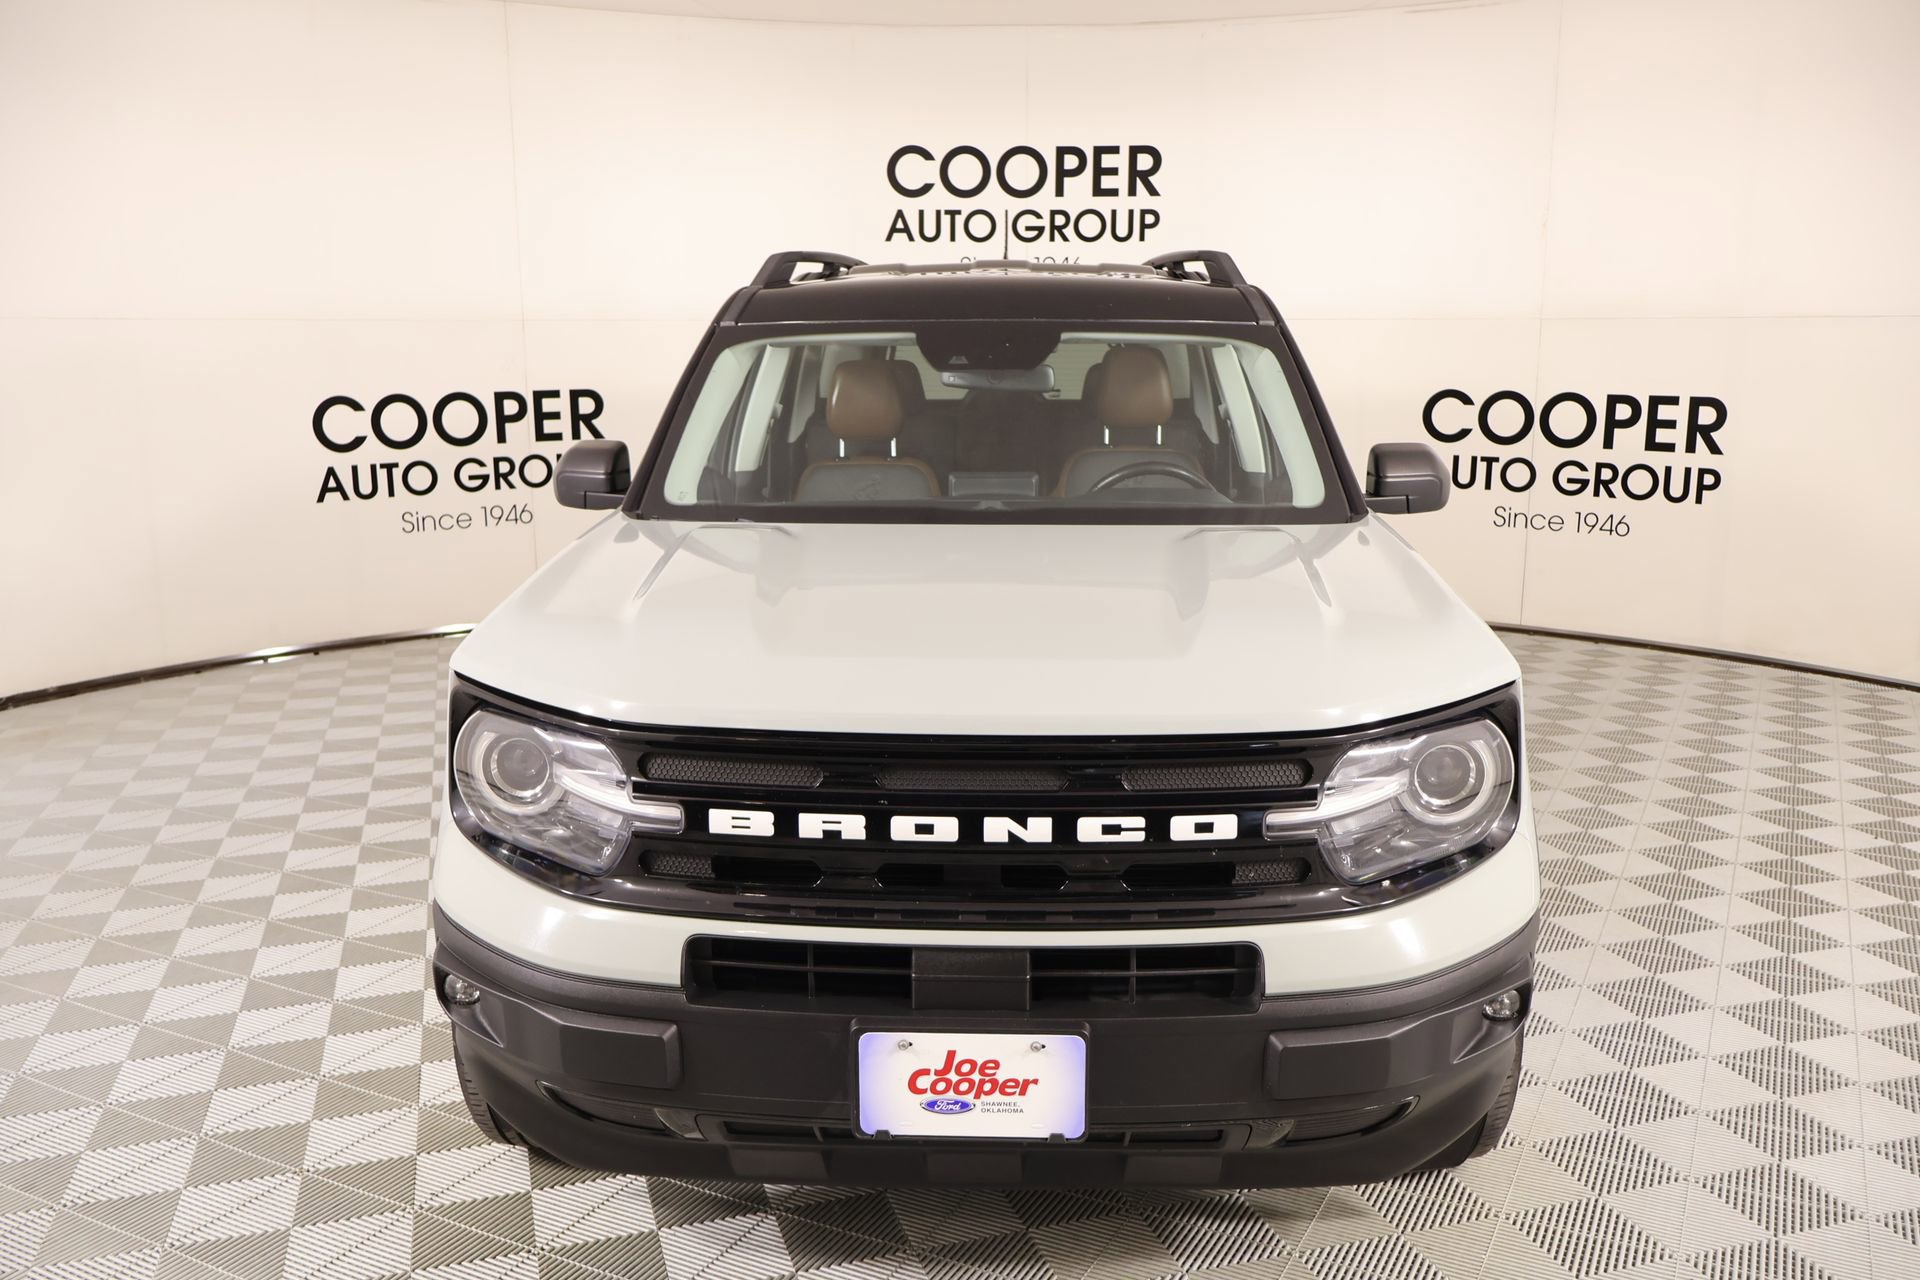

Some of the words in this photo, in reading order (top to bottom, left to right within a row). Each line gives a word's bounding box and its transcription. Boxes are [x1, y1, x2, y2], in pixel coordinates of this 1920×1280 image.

[887, 145, 1162, 199] COOPER
[885, 209, 997, 243] AUTO
[1011, 209, 1160, 243] GROUP
[312, 389, 605, 453] COOPER
[1422, 388, 1728, 455] COOPER
[316, 460, 438, 503] AUTO
[454, 454, 561, 492] GRO
[1452, 455, 1536, 493] UTO
[1552, 460, 1721, 505] GROUP
[402, 511, 472, 533] Since
[481, 503, 533, 527] 1946
[1493, 506, 1564, 532] Since
[1574, 511, 1630, 537] 1946
[708, 808, 1238, 843] BRONCO
[934, 1050, 1000, 1077] Joe
[908, 1068, 1039, 1100] Cooper
[933, 1100, 962, 1111] Ford
